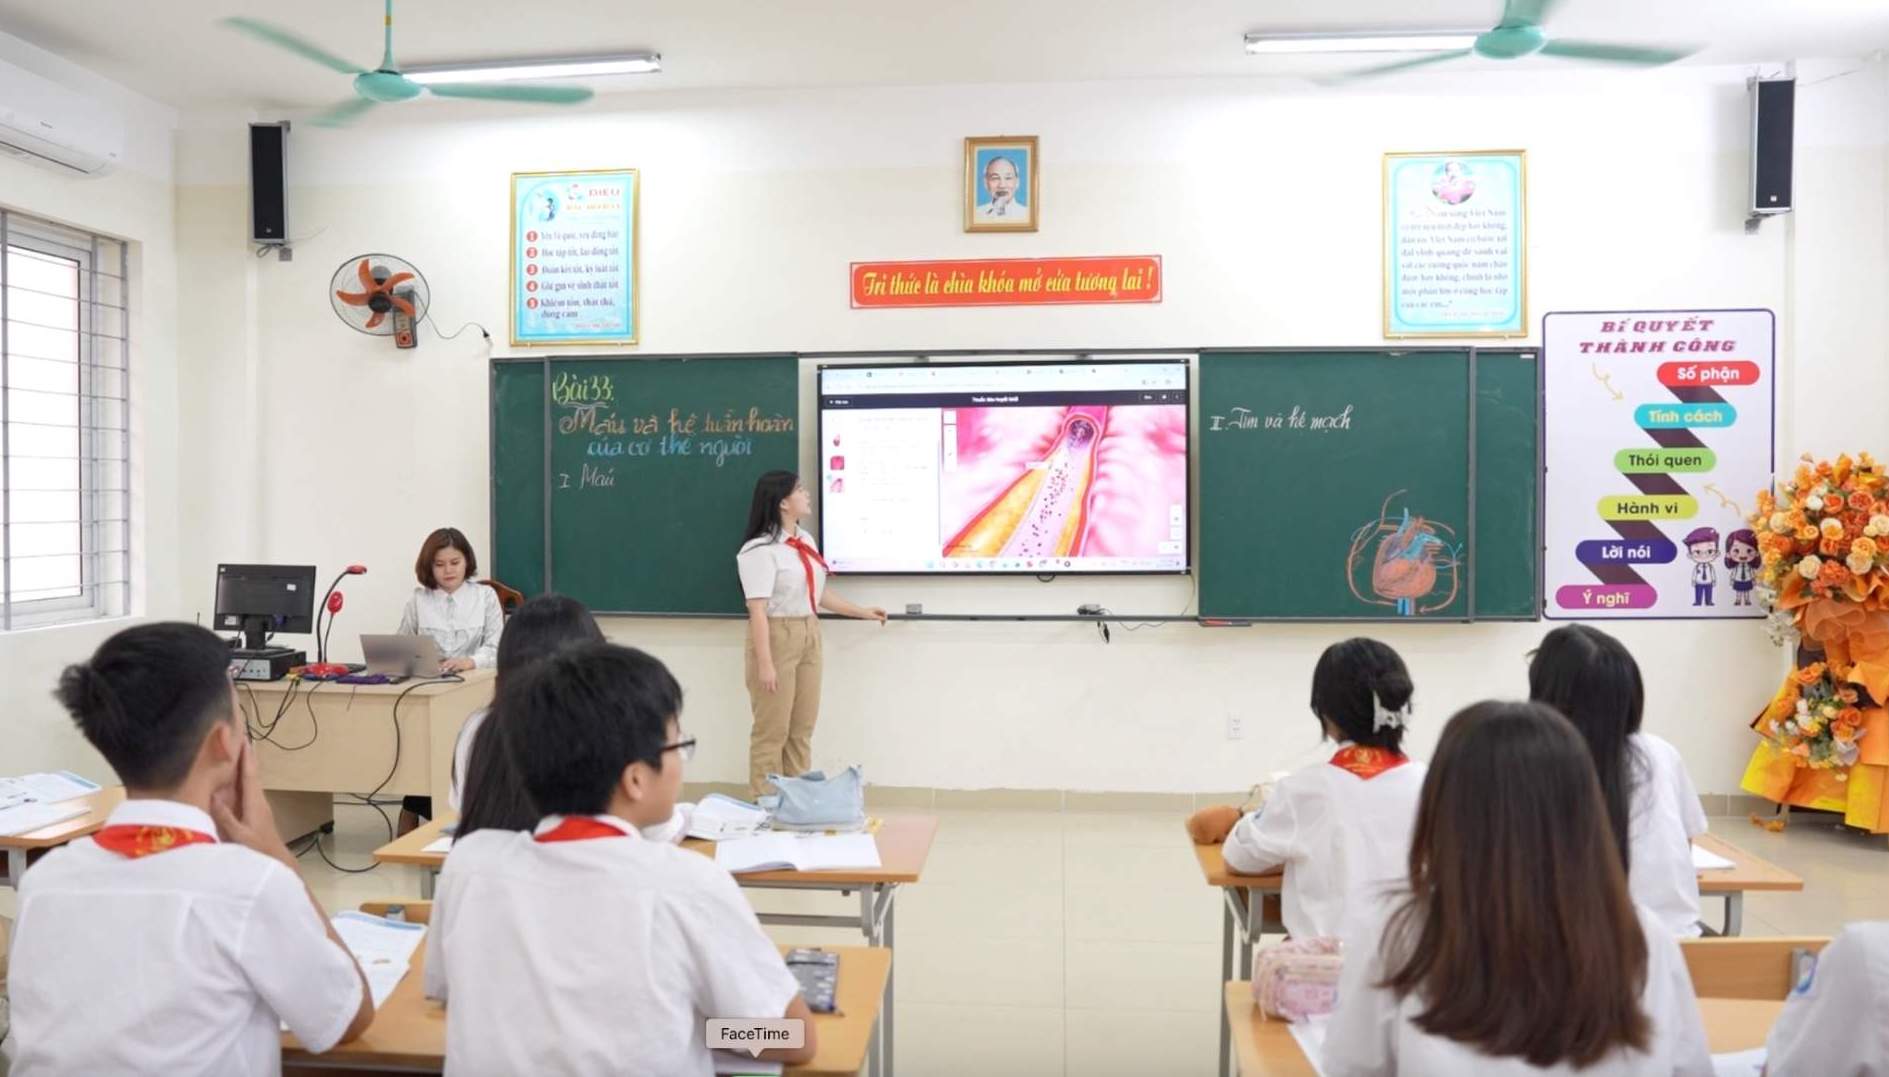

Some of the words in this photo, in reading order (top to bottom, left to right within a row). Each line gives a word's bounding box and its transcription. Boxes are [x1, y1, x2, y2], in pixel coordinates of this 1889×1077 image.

[890, 271, 922, 295] thức
[925, 271, 939, 294] là
[943, 270, 974, 294] chìa
[978, 269, 1014, 293] khóa
[1018, 266, 1042, 292] mở
[1046, 268, 1072, 292] cửa
[1074, 271, 1118, 299] tương
[1121, 266, 1143, 290] lai
[1145, 265, 1153, 289] !
[1601, 319, 1631, 333] BÍ
[1633, 316, 1715, 332] QUYẾT
[1580, 338, 1665, 353] THÀNH
[1673, 338, 1736, 352] CÔNG
[1677, 365, 1697, 380] Số
[1700, 365, 1740, 383] phận
[552, 372, 588, 405] Bài
[1649, 410, 1679, 423] Tính
[1684, 409, 1723, 422] cách
[1629, 453, 1660, 467] Thói
[1664, 455, 1702, 470] quen
[1617, 502, 1659, 514] Hành
[1665, 502, 1679, 514] vi
[1602, 546, 1623, 559] Lời
[1627, 546, 1651, 559] nói
[1583, 588, 1594, 604] Ý
